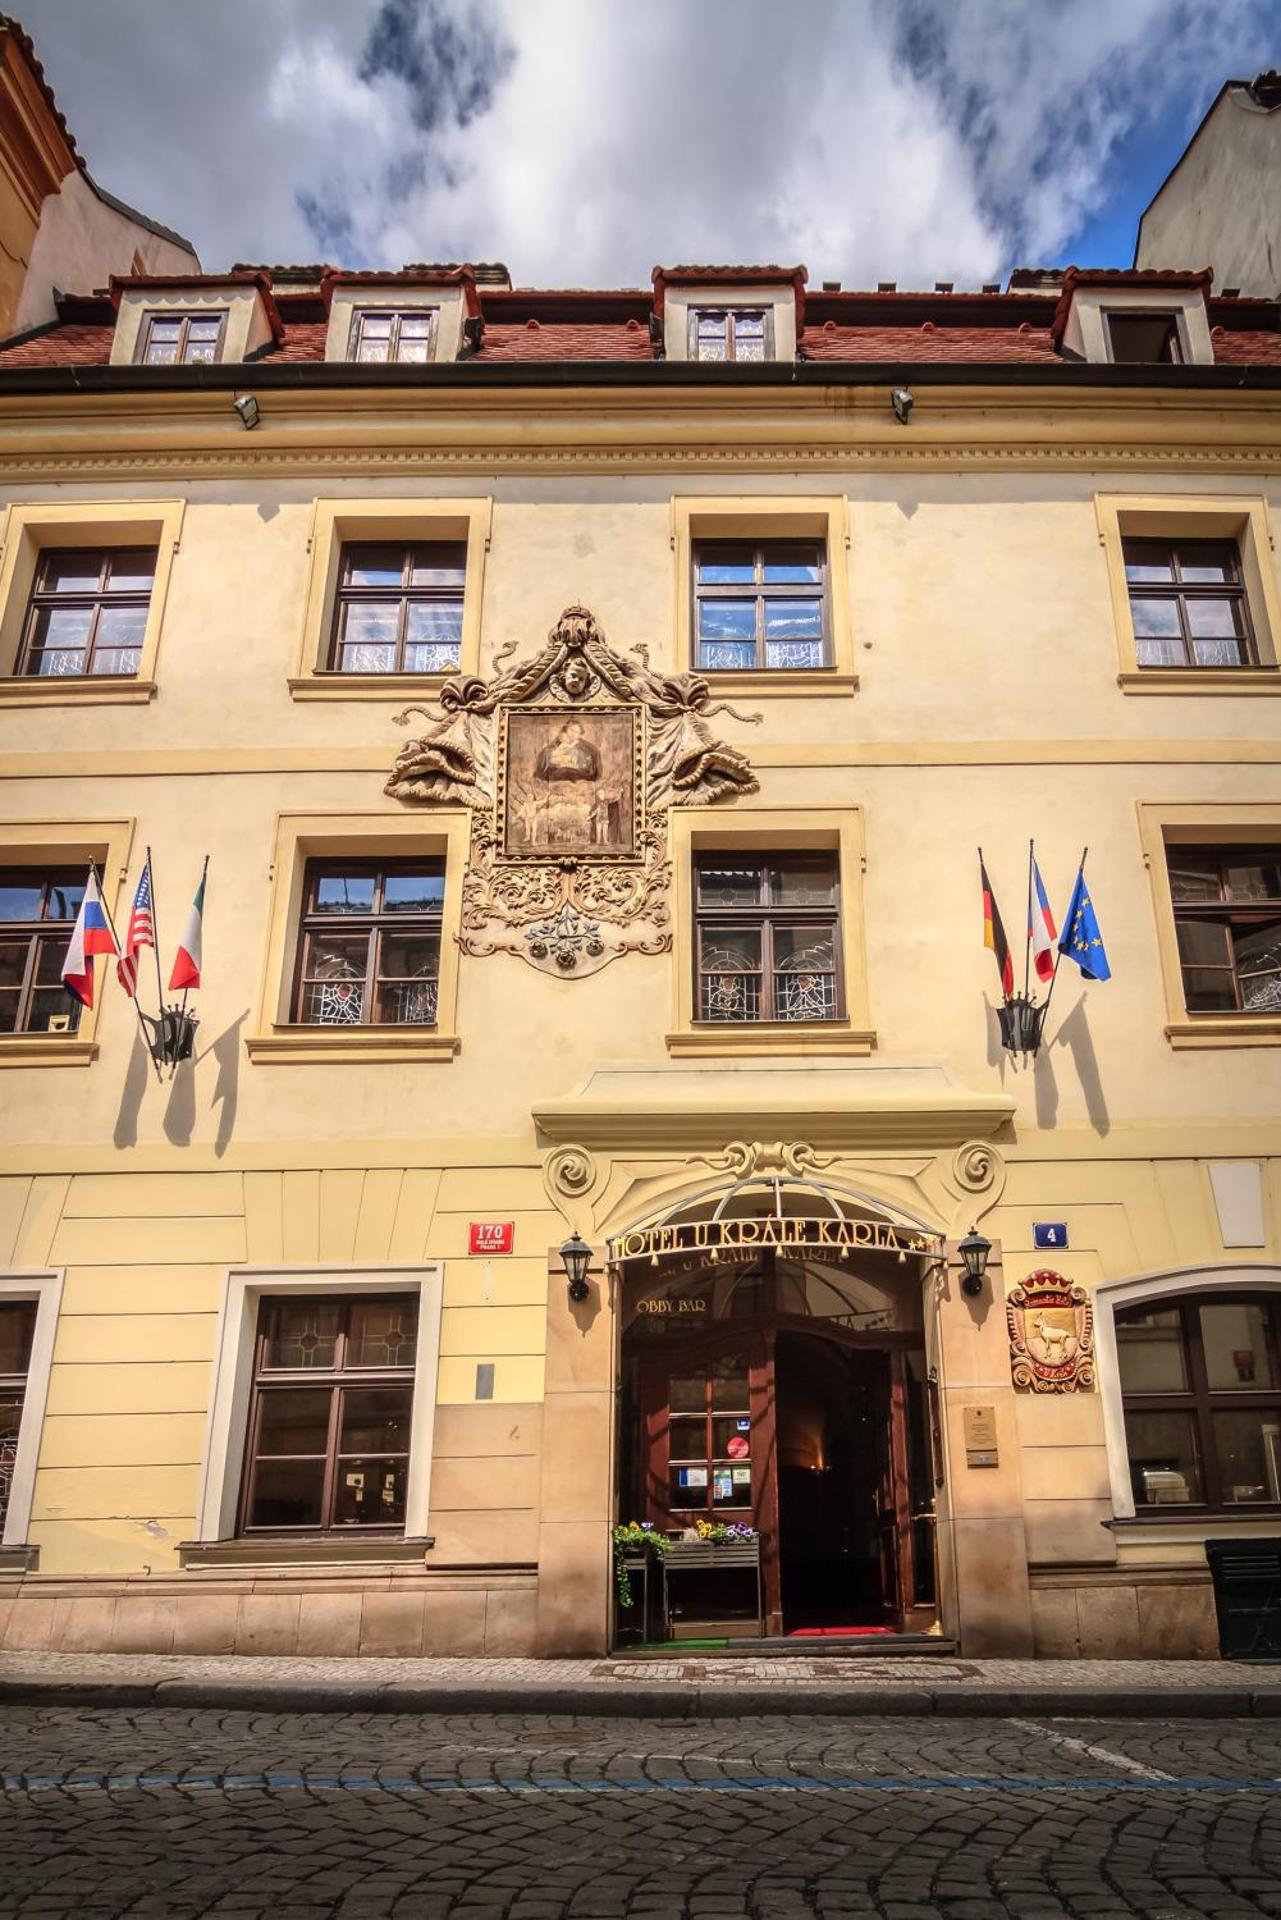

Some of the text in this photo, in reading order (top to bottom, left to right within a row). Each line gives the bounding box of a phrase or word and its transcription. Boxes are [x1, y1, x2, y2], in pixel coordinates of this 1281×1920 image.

[478, 1225, 503, 1239] 170
[614, 1214, 899, 1258] HOTEL U KRÁLE KARLA
[1047, 1228, 1056, 1242] 4
[636, 1299, 706, 1313] OBBY BAR
